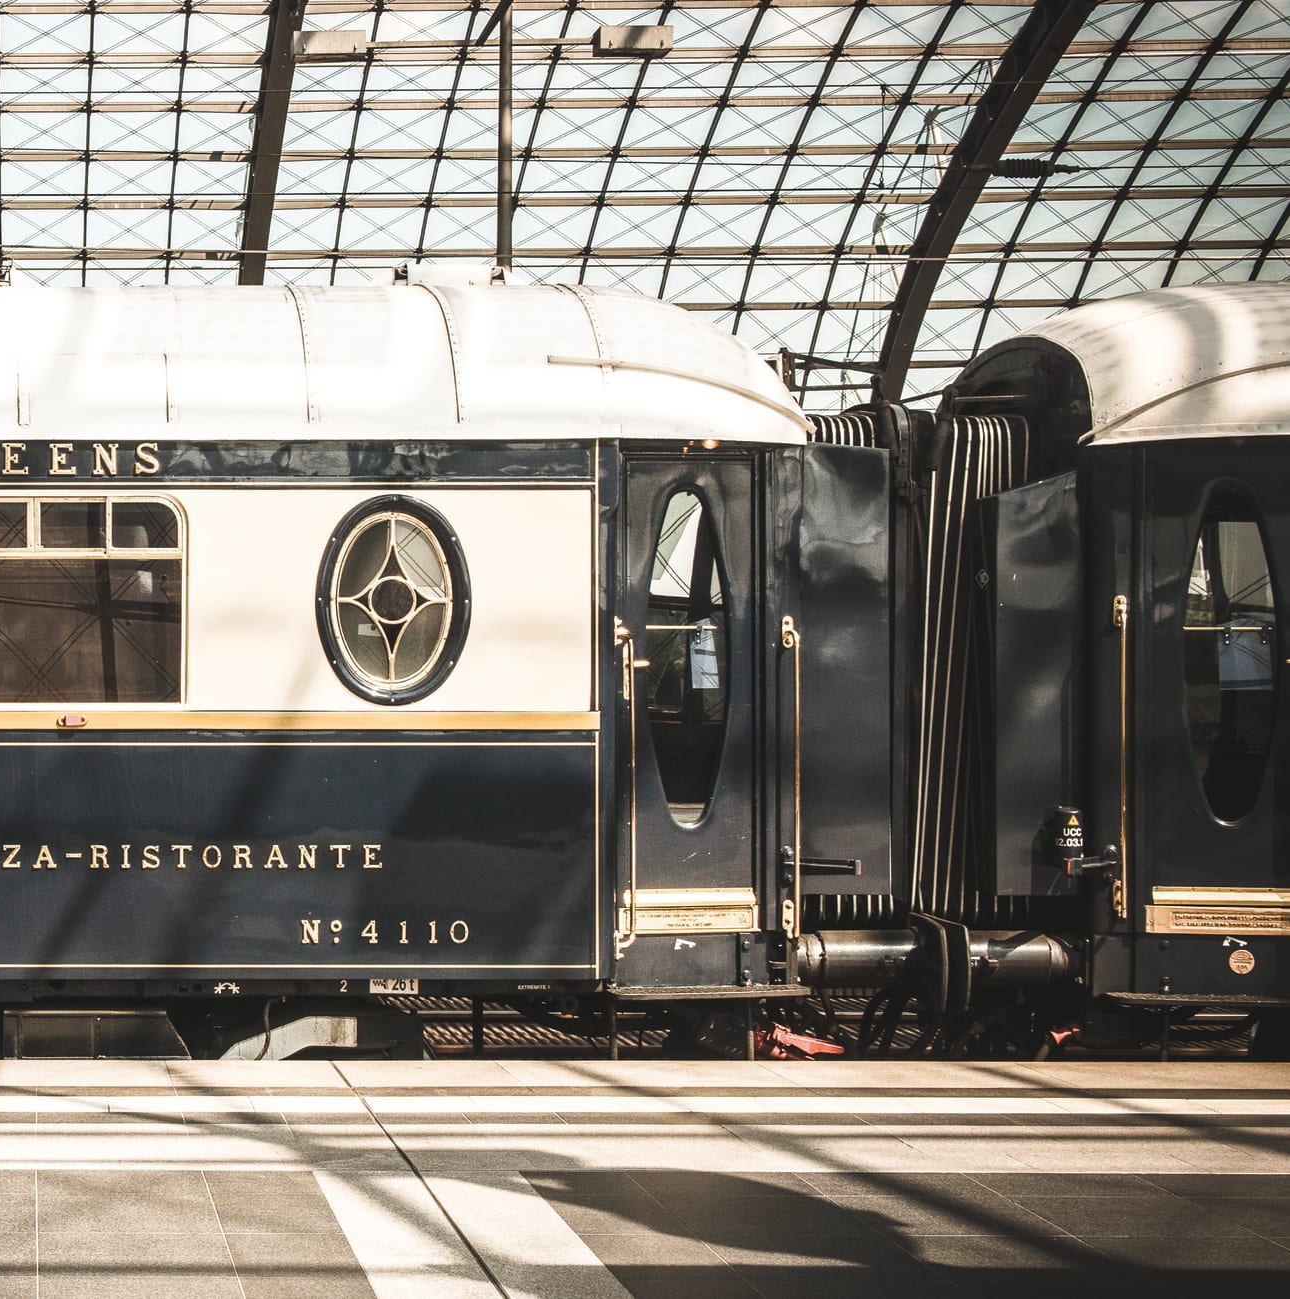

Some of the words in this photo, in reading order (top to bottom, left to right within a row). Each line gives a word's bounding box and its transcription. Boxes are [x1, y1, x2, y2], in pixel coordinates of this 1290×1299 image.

[1063, 827, 1082, 837] UCC
[360, 919, 470, 944] 4110
[339, 979, 348, 993] 2
[392, 978, 407, 991] 26
[409, 978, 415, 991] t
